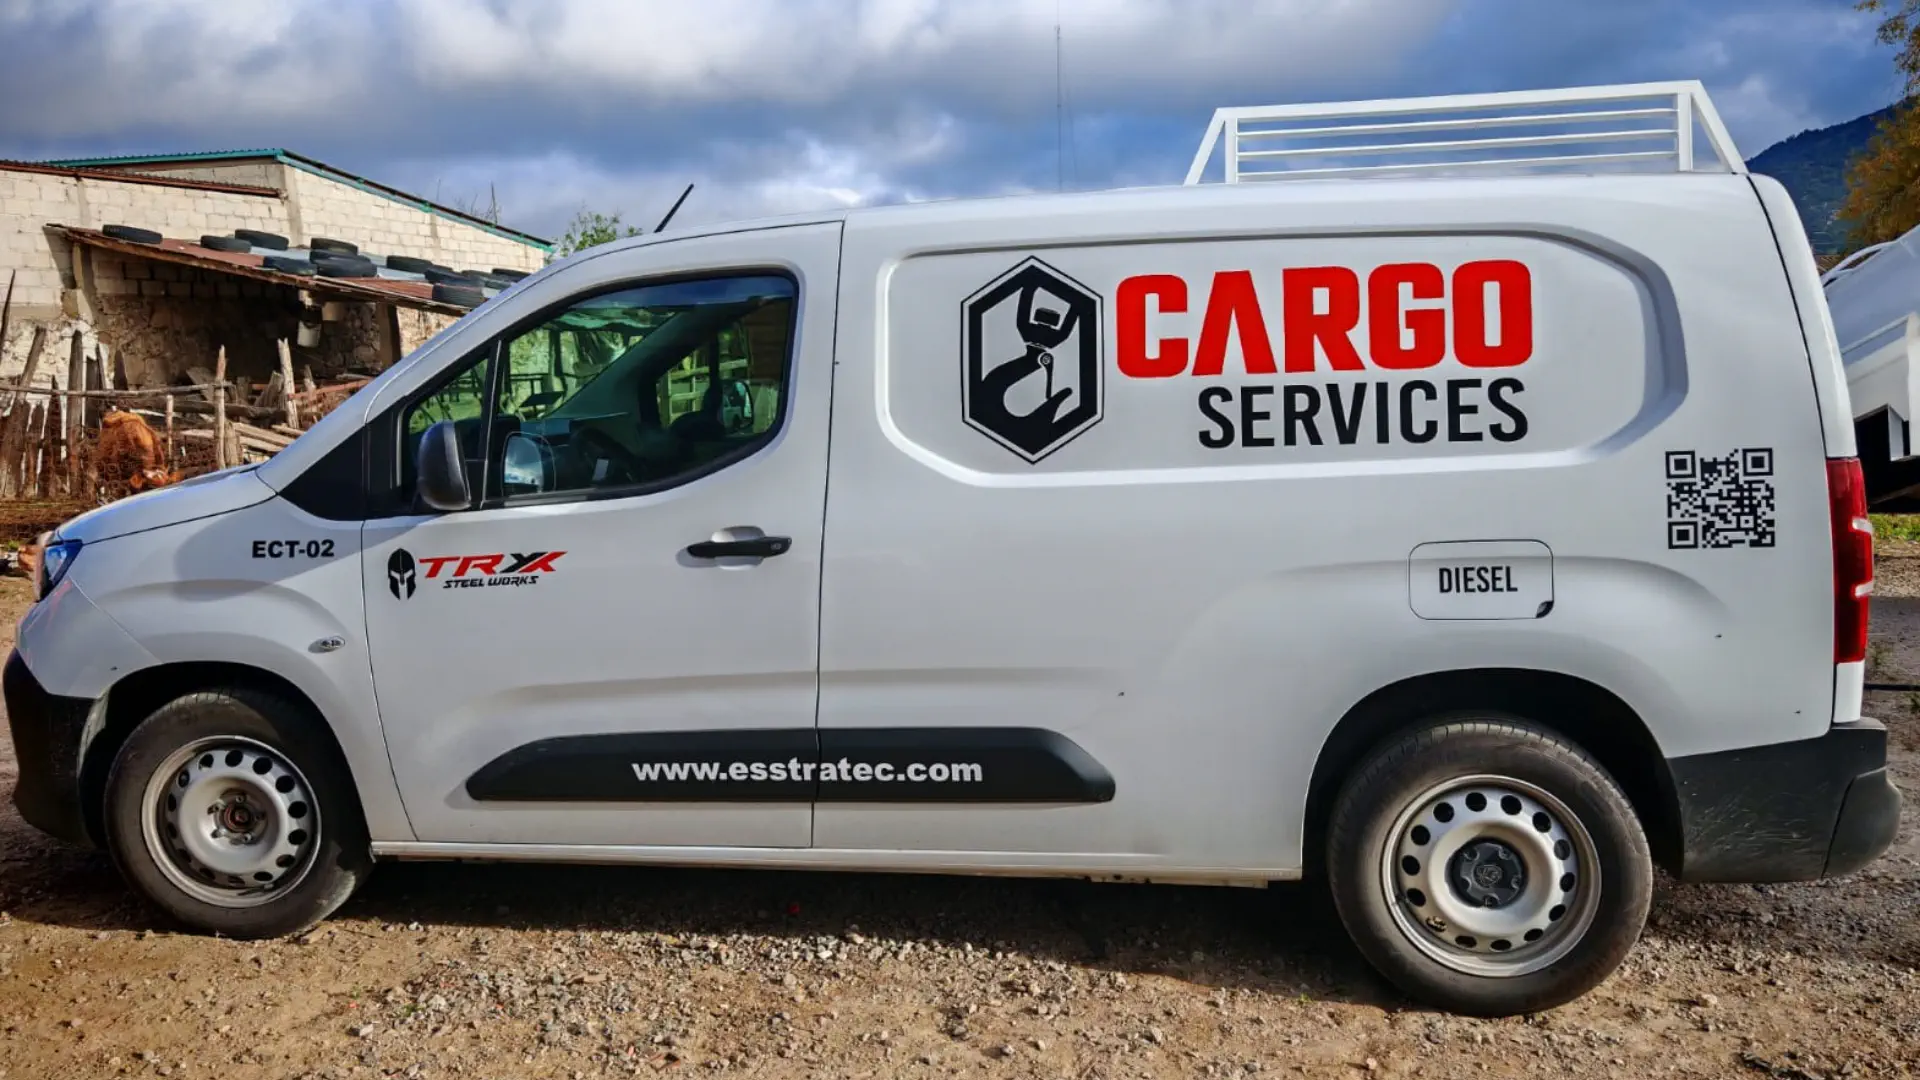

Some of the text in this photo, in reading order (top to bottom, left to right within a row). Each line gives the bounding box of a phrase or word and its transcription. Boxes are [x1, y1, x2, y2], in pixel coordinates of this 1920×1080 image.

[1116, 259, 1533, 378] CARGO
[1198, 377, 1528, 448] SERVICES
[252, 539, 335, 558] ECT-02
[443, 575, 540, 589] STEEL WORKS
[1438, 566, 1519, 594] DIESEL
[632, 757, 983, 781] www.esstratec.com
